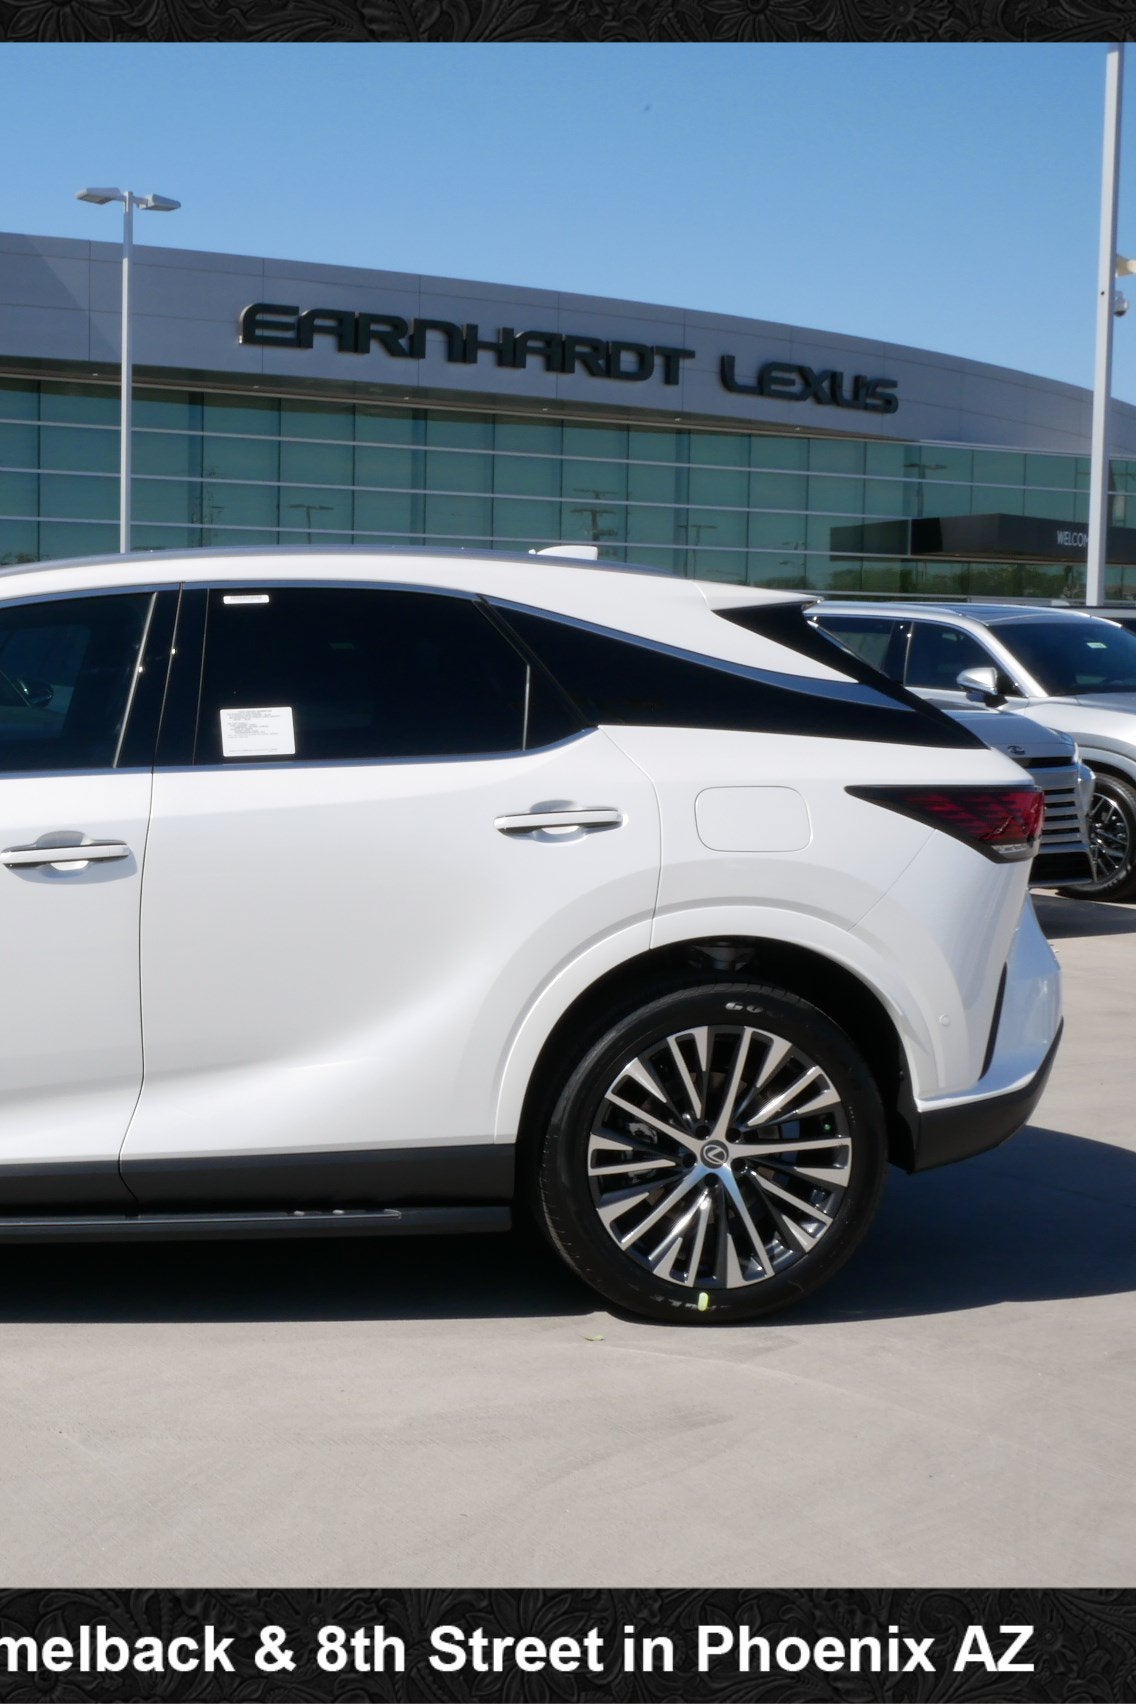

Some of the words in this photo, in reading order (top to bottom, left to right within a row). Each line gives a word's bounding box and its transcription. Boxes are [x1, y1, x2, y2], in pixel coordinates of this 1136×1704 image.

[239, 303, 695, 386] EARNHARDT
[720, 355, 899, 414] LEXUS
[1056, 530, 1089, 547] WELCOM
